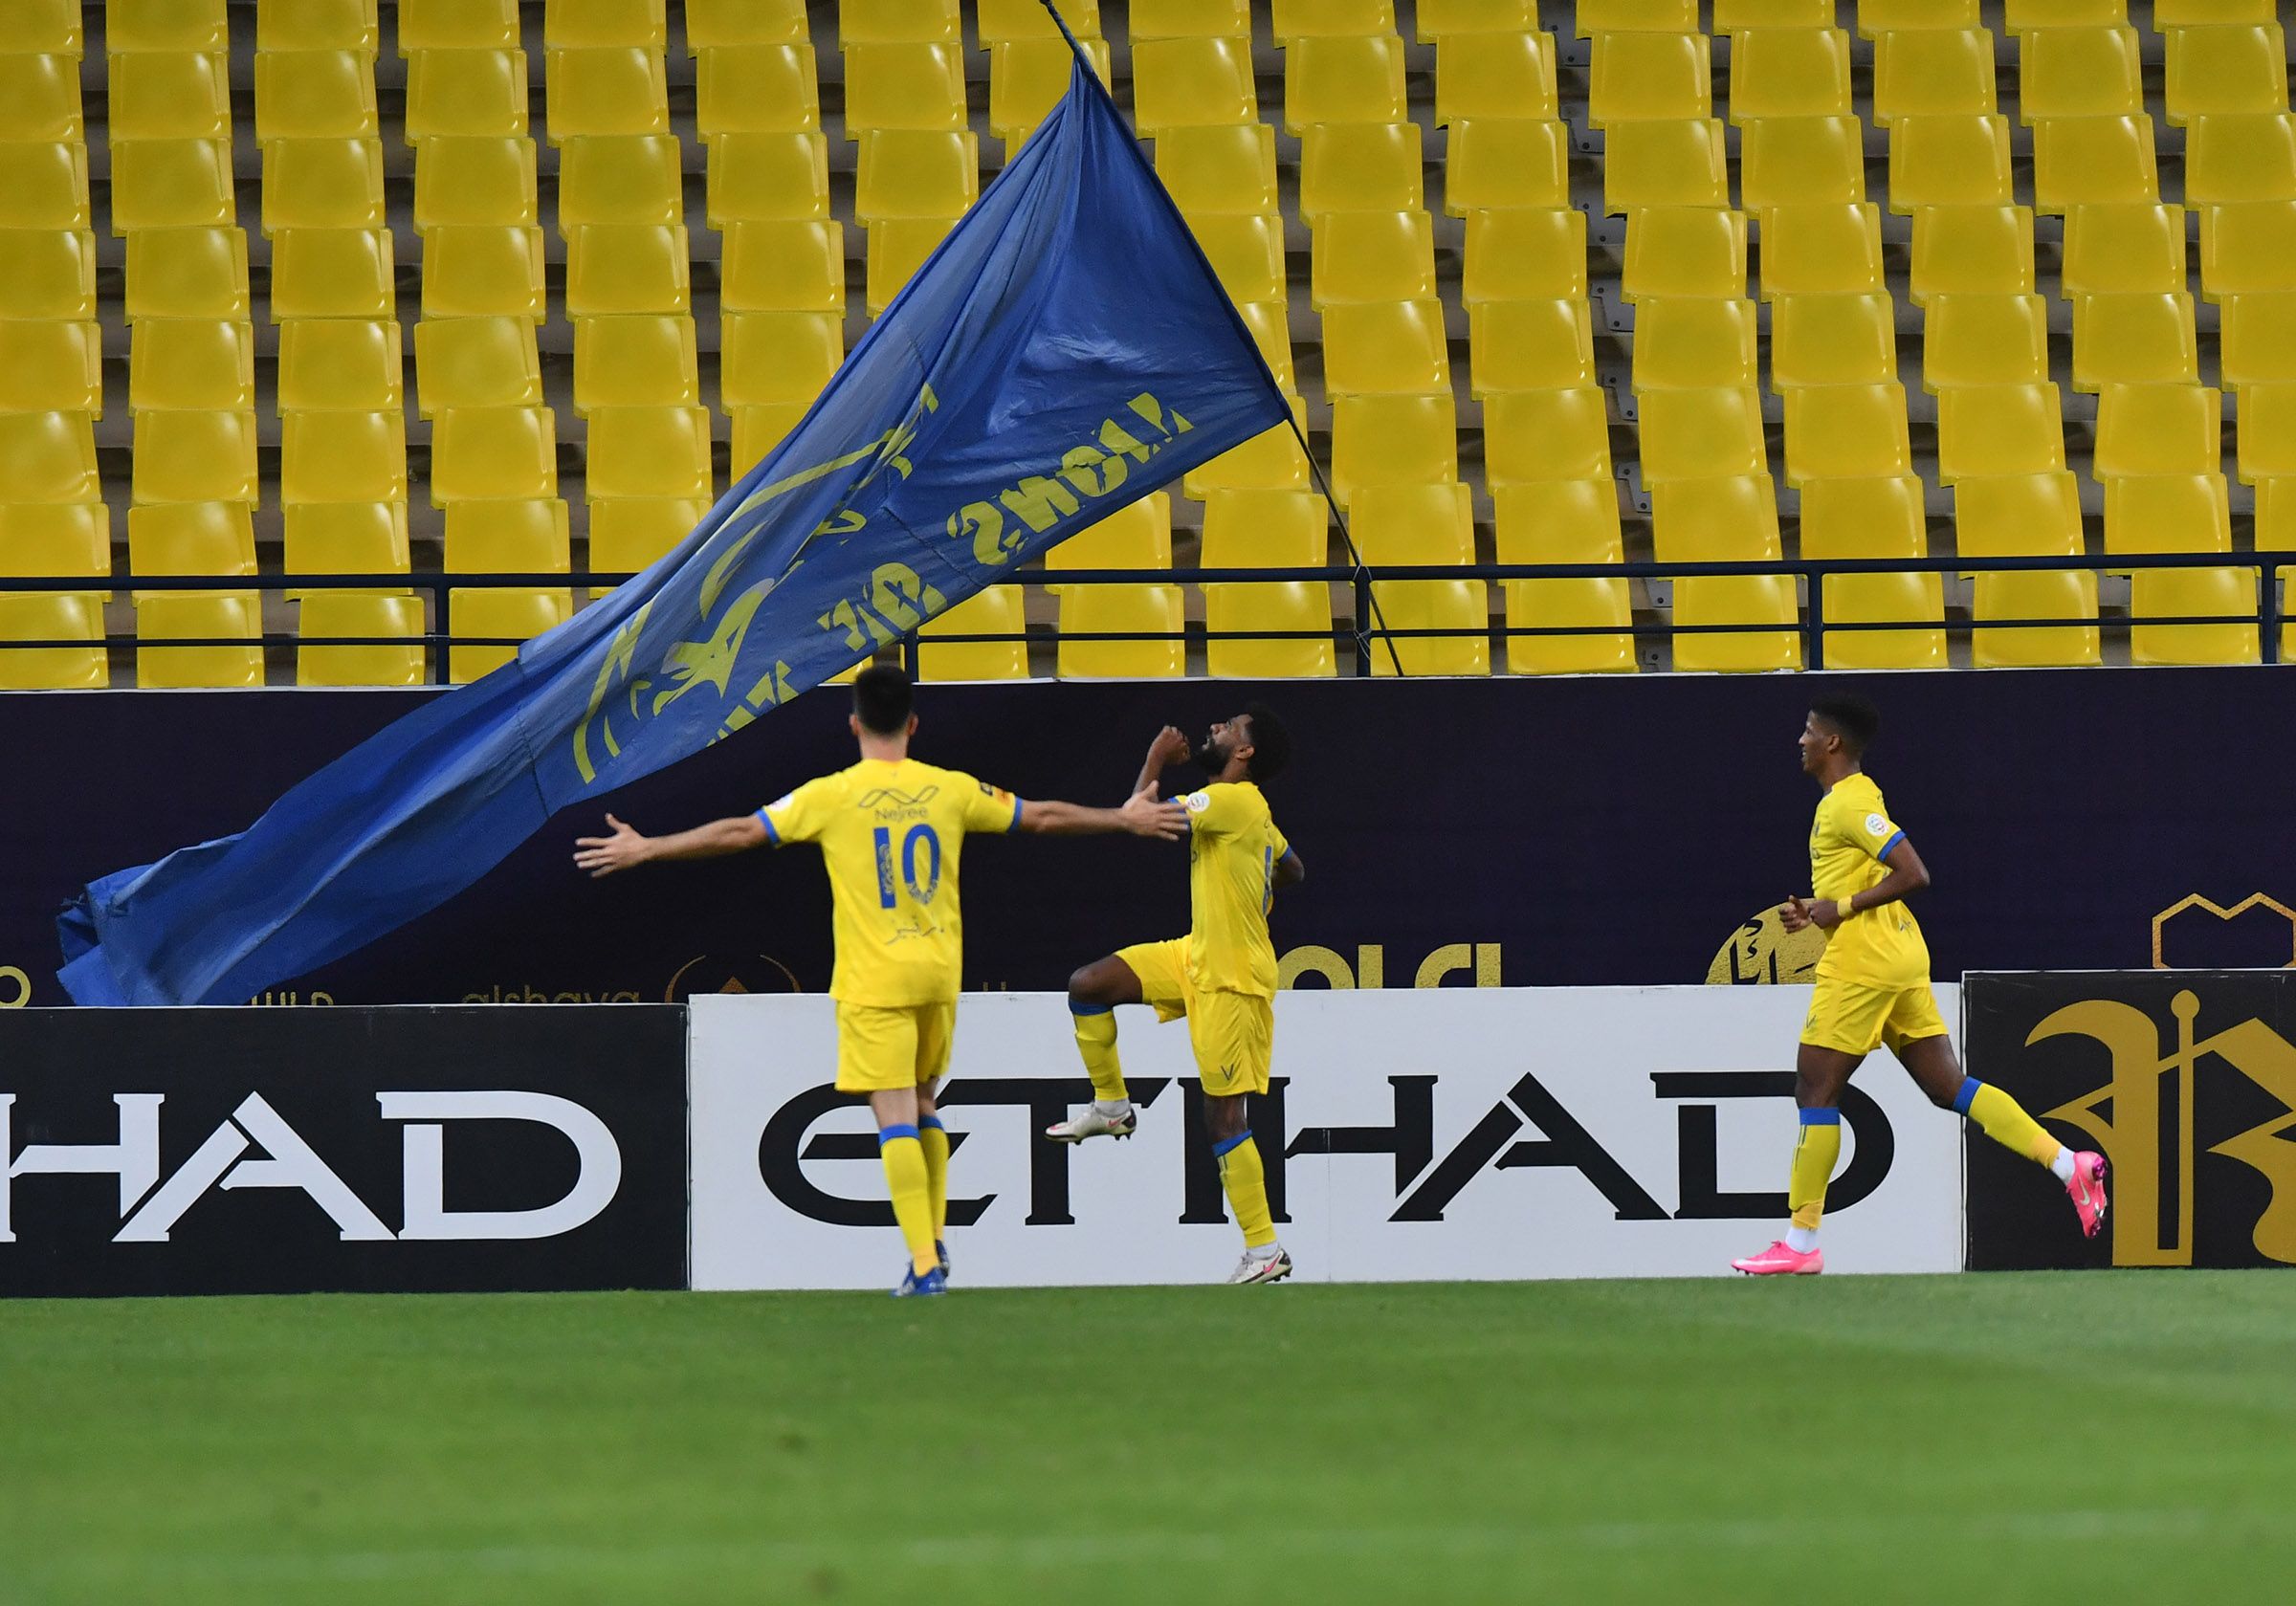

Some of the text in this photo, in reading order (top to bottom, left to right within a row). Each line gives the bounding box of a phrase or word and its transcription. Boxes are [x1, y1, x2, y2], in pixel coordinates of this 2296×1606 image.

[874, 804, 928, 824] Nejree
[873, 823, 940, 910] 10
[758, 1071, 1895, 1227] ETIHAD
